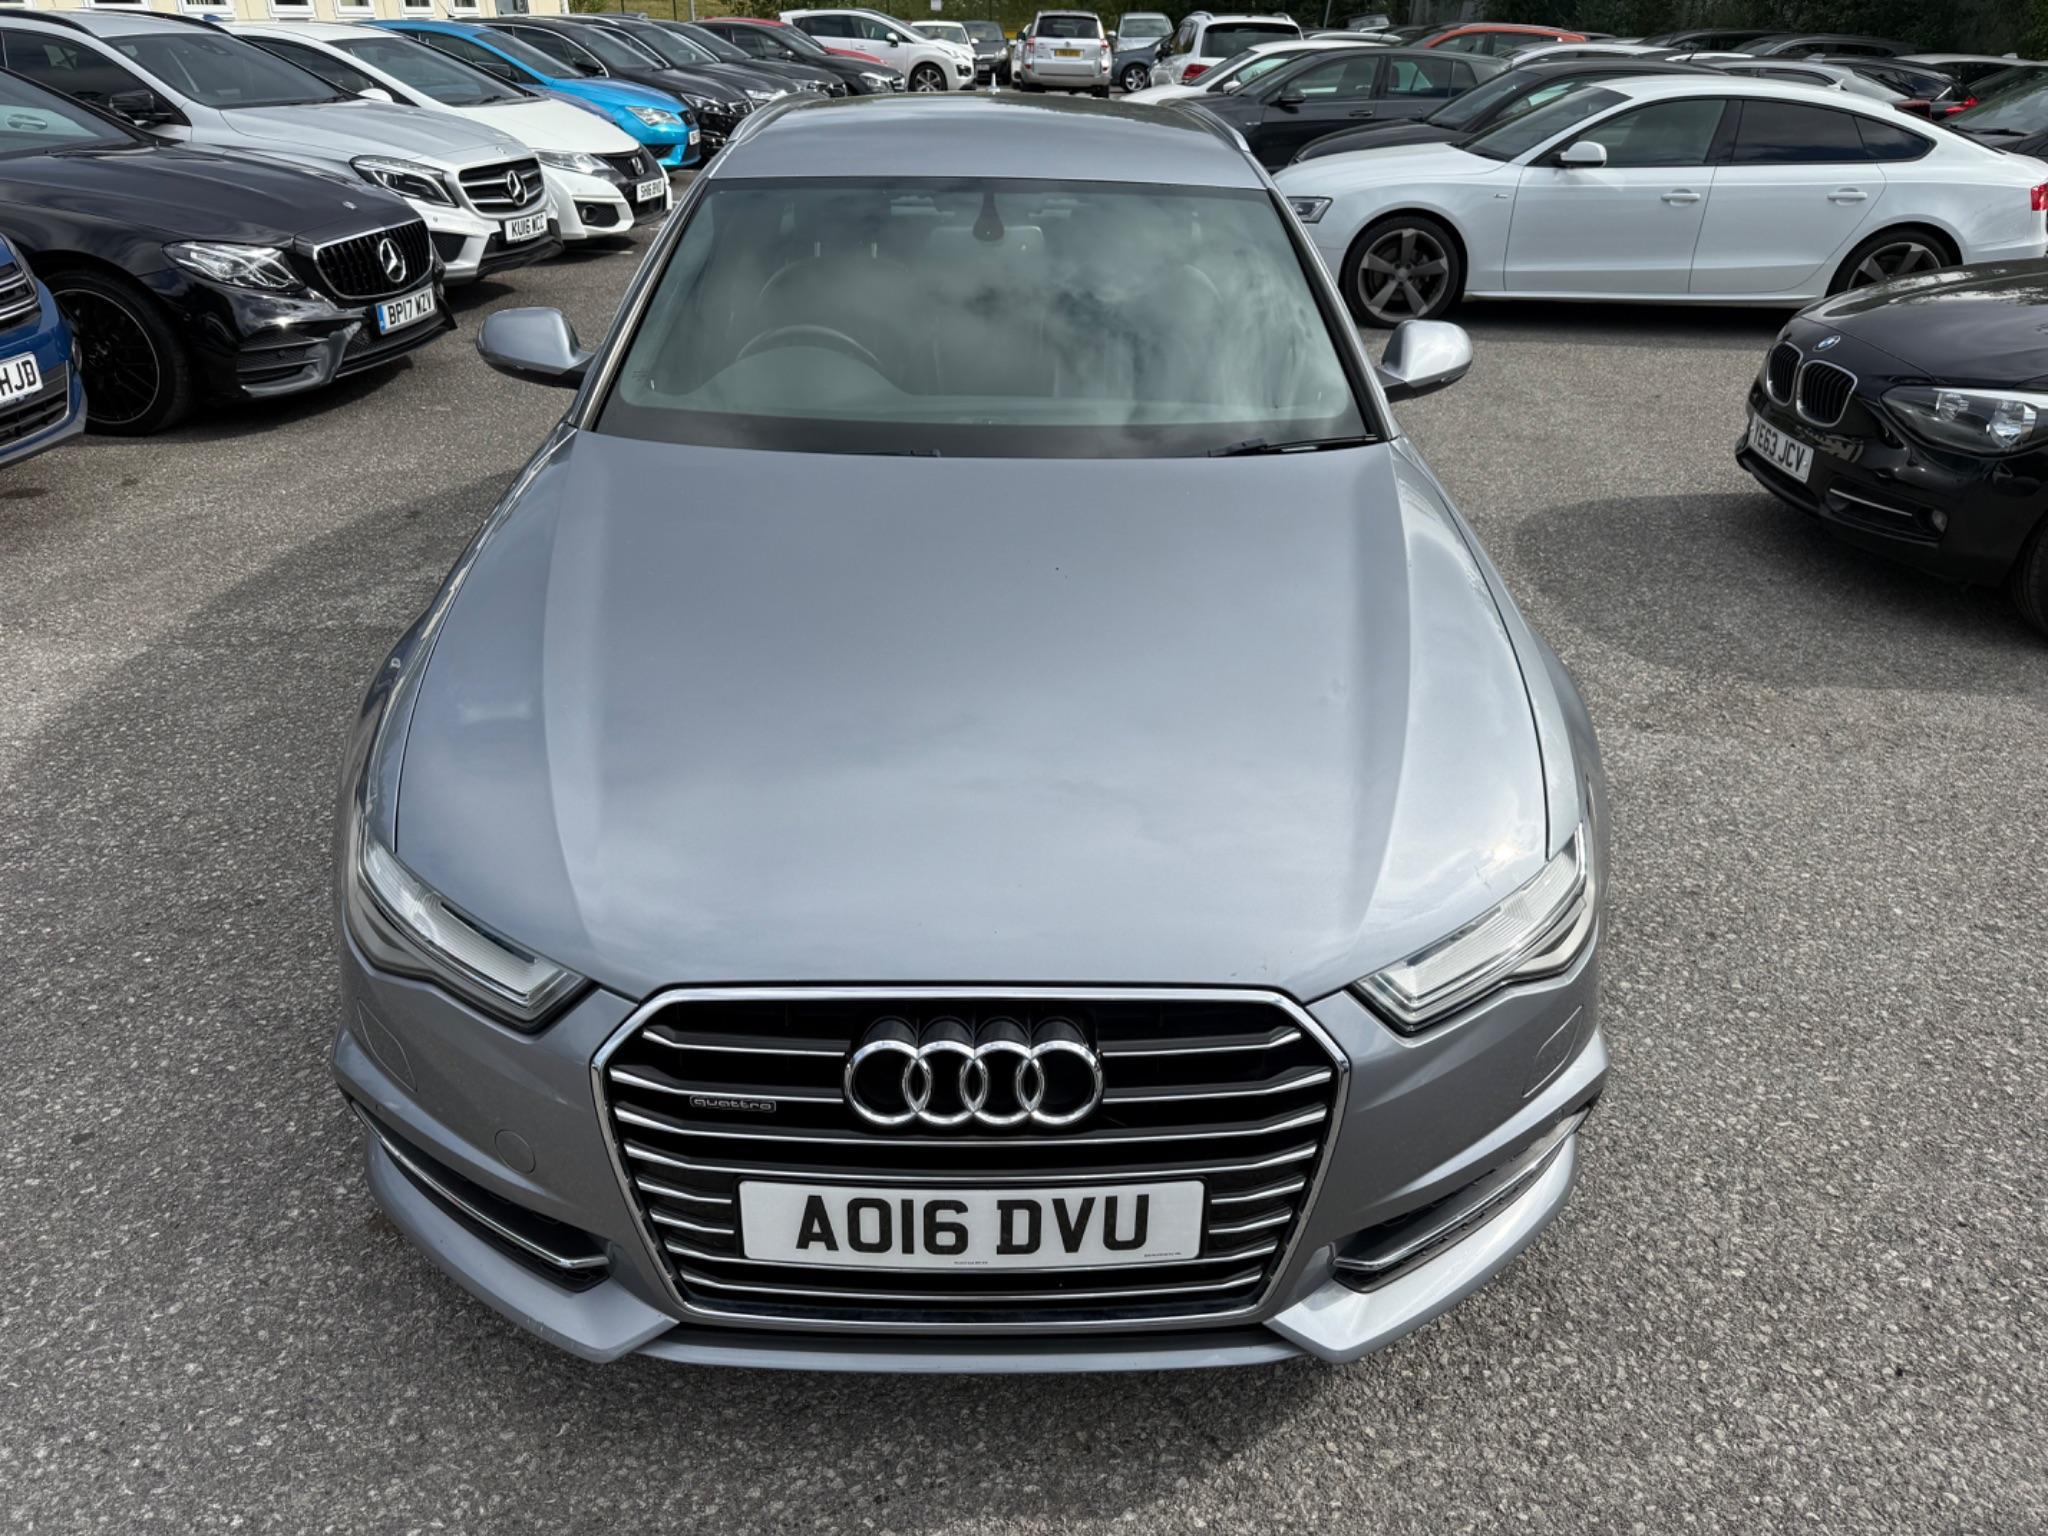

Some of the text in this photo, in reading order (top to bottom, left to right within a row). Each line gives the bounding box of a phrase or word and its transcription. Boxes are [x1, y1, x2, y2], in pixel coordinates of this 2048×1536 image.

[511, 218, 530, 238] KU16
[387, 298, 413, 325] BP17
[1753, 419, 1806, 472] YE63 JCV
[693, 1098, 772, 1110] quattro
[795, 1193, 1151, 1256] AO16 DVU
